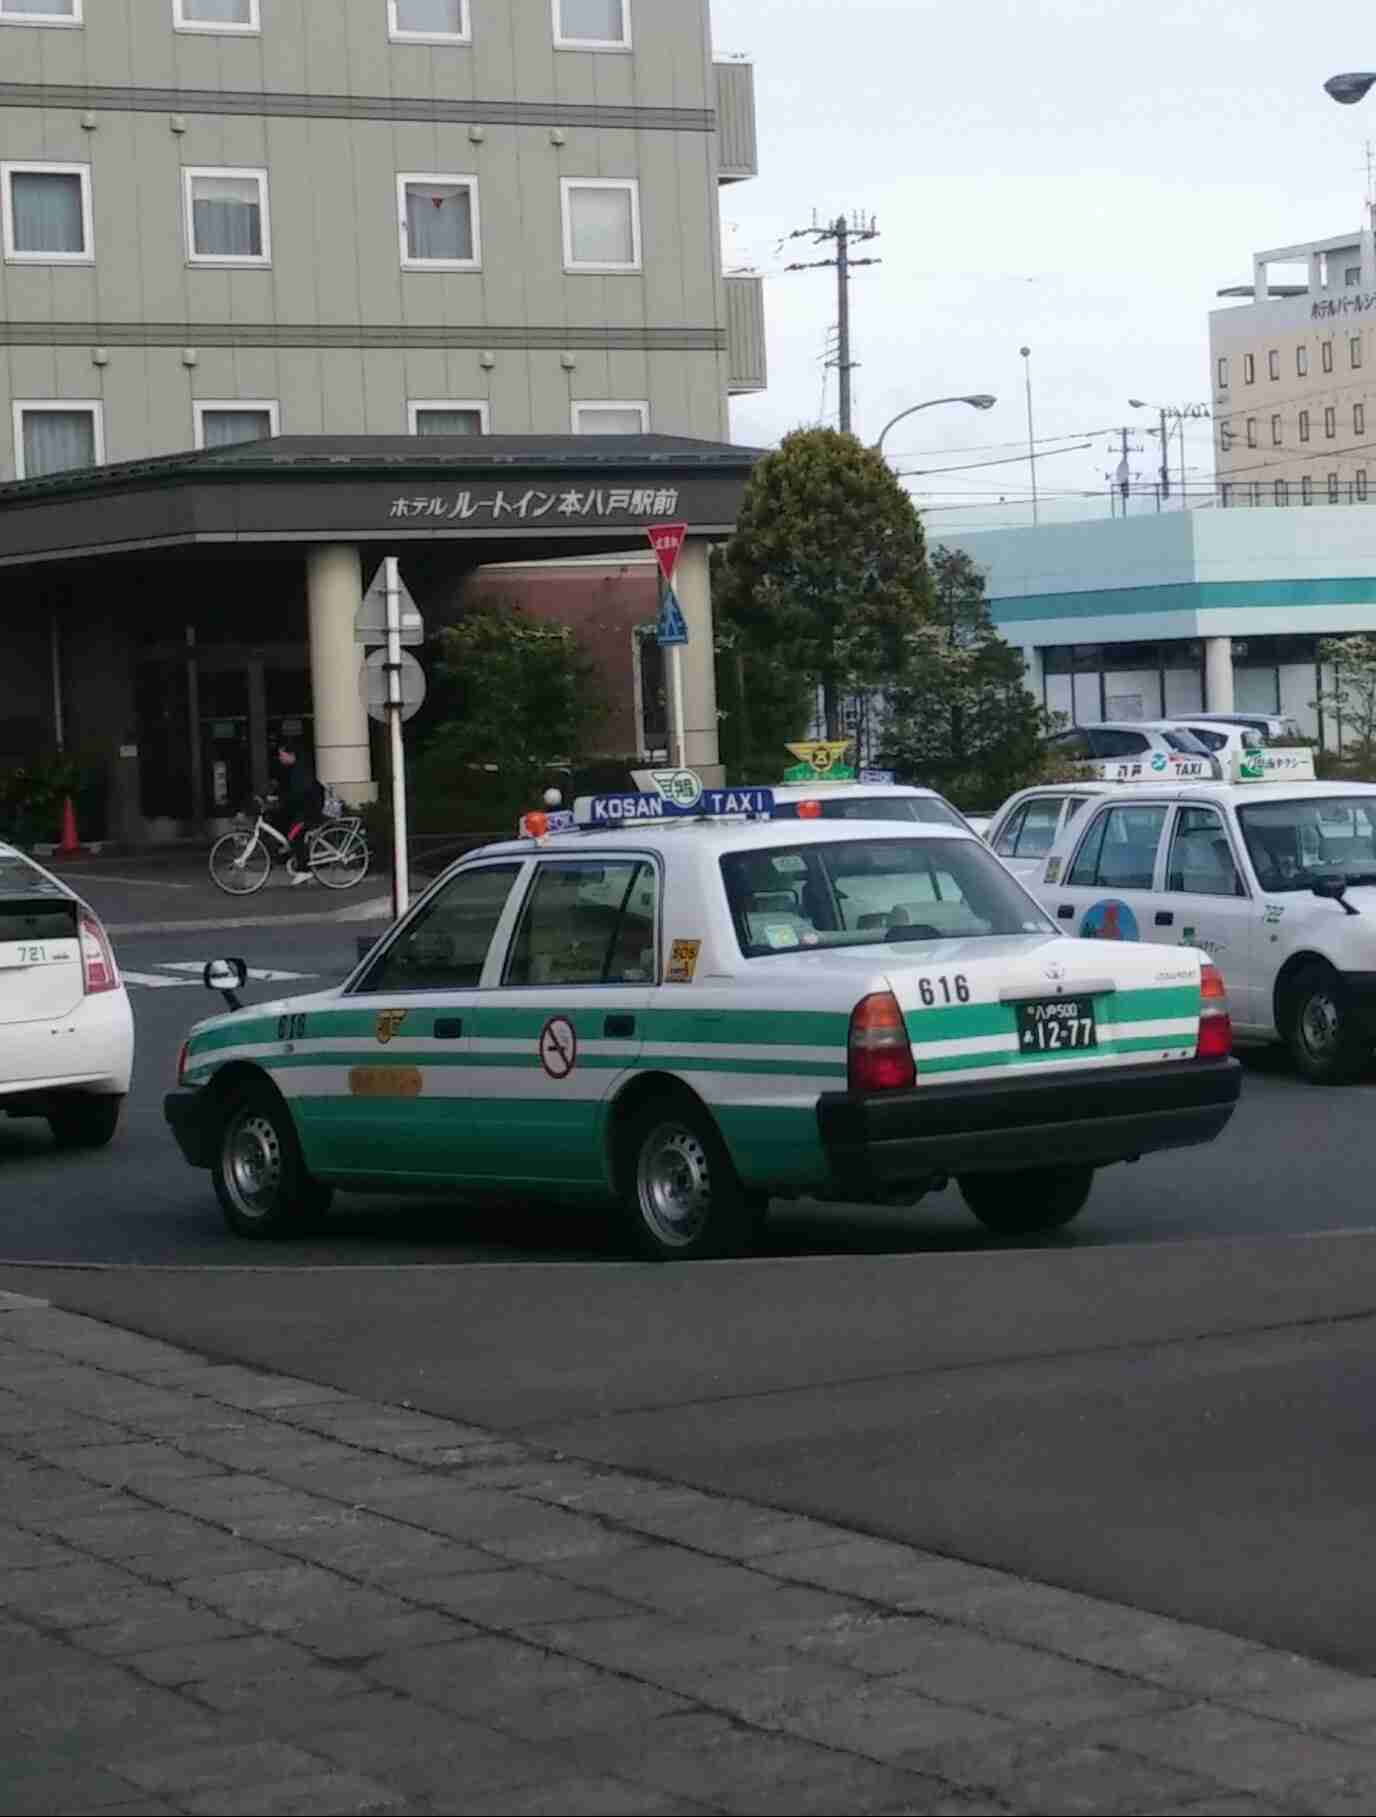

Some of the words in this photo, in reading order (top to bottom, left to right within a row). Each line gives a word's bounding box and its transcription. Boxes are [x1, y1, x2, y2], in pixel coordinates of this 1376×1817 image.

[594, 796, 663, 820] KOSAN
[712, 793, 763, 813] TAXI
[919, 974, 970, 1005] 616
[1037, 1018, 1092, 1049] 12-77
